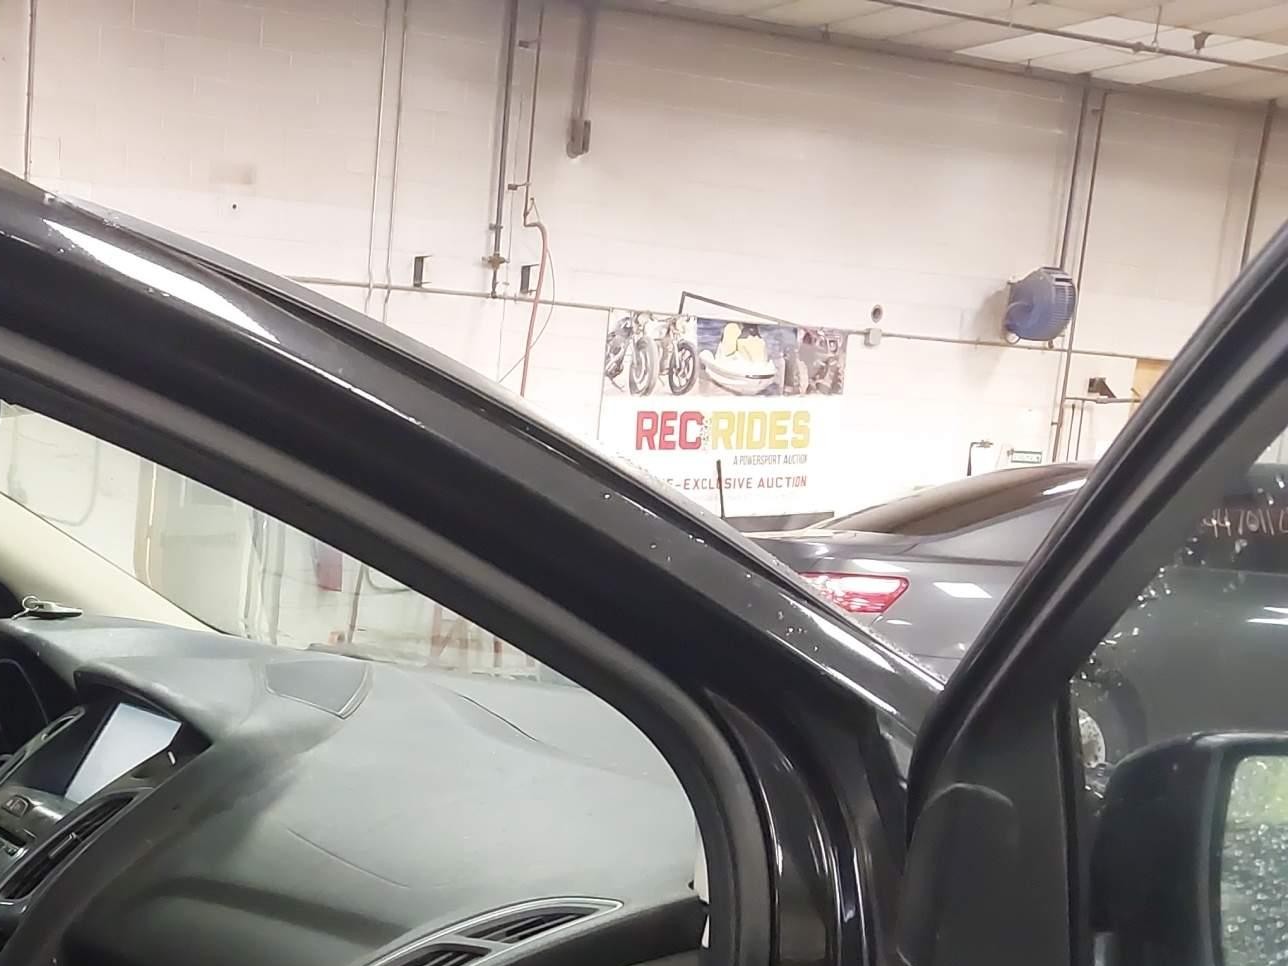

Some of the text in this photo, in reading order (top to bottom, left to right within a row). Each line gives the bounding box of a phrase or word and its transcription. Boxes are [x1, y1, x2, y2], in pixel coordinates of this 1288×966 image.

[711, 410, 811, 450] RIDES
[733, 453, 808, 466] A POWERSPORT AUCTION
[757, 475, 808, 489] AUCTION
